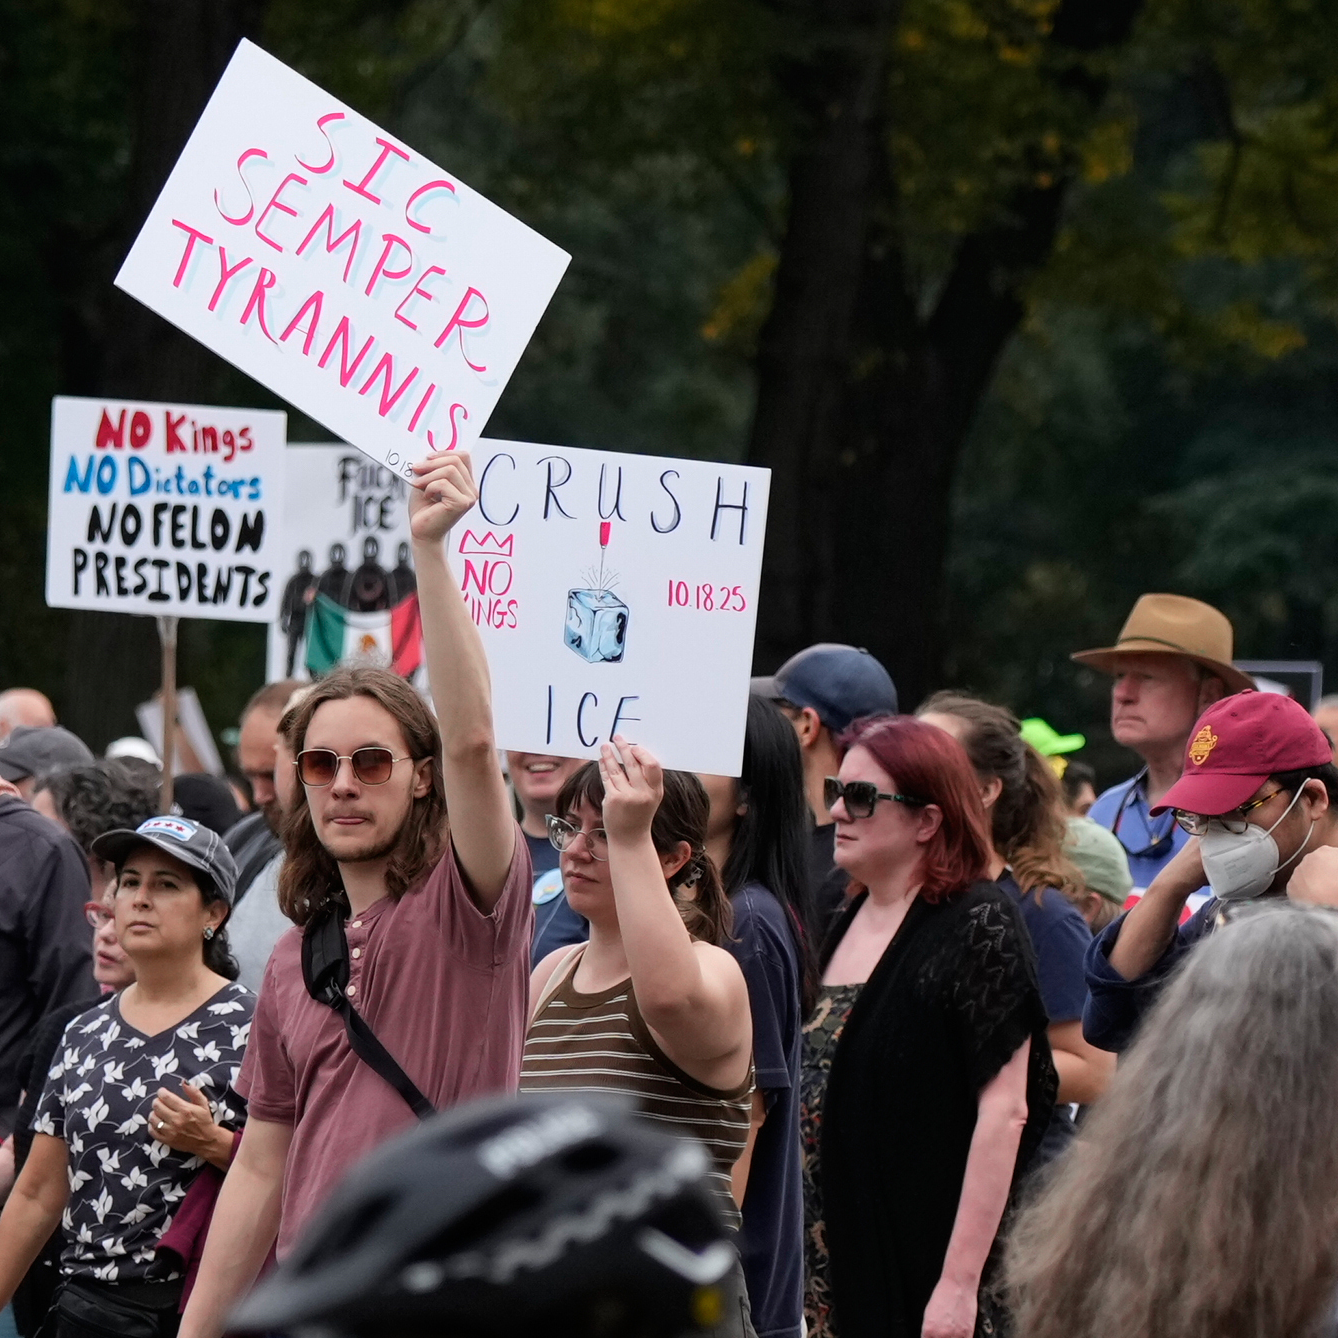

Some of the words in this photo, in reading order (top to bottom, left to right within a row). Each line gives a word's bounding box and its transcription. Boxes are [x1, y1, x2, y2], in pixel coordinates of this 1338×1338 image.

[294, 112, 457, 235] SIC
[213, 148, 490, 373] SEMPER
[171, 218, 469, 452] TYRANNIS
[95, 407, 153, 450] NO
[165, 410, 254, 462] Kings
[63, 454, 118, 496] NO
[128, 455, 262, 501] Dictators
[478, 453, 749, 546] CRUSH
[87, 503, 143, 547] NO
[152, 502, 265, 554] FELON
[72, 547, 271, 608] PRESIDENTS
[461, 558, 513, 596] NO
[667, 579, 748, 613] 10.18.25
[463, 592, 520, 629] INGS
[545, 684, 642, 748] ICE
